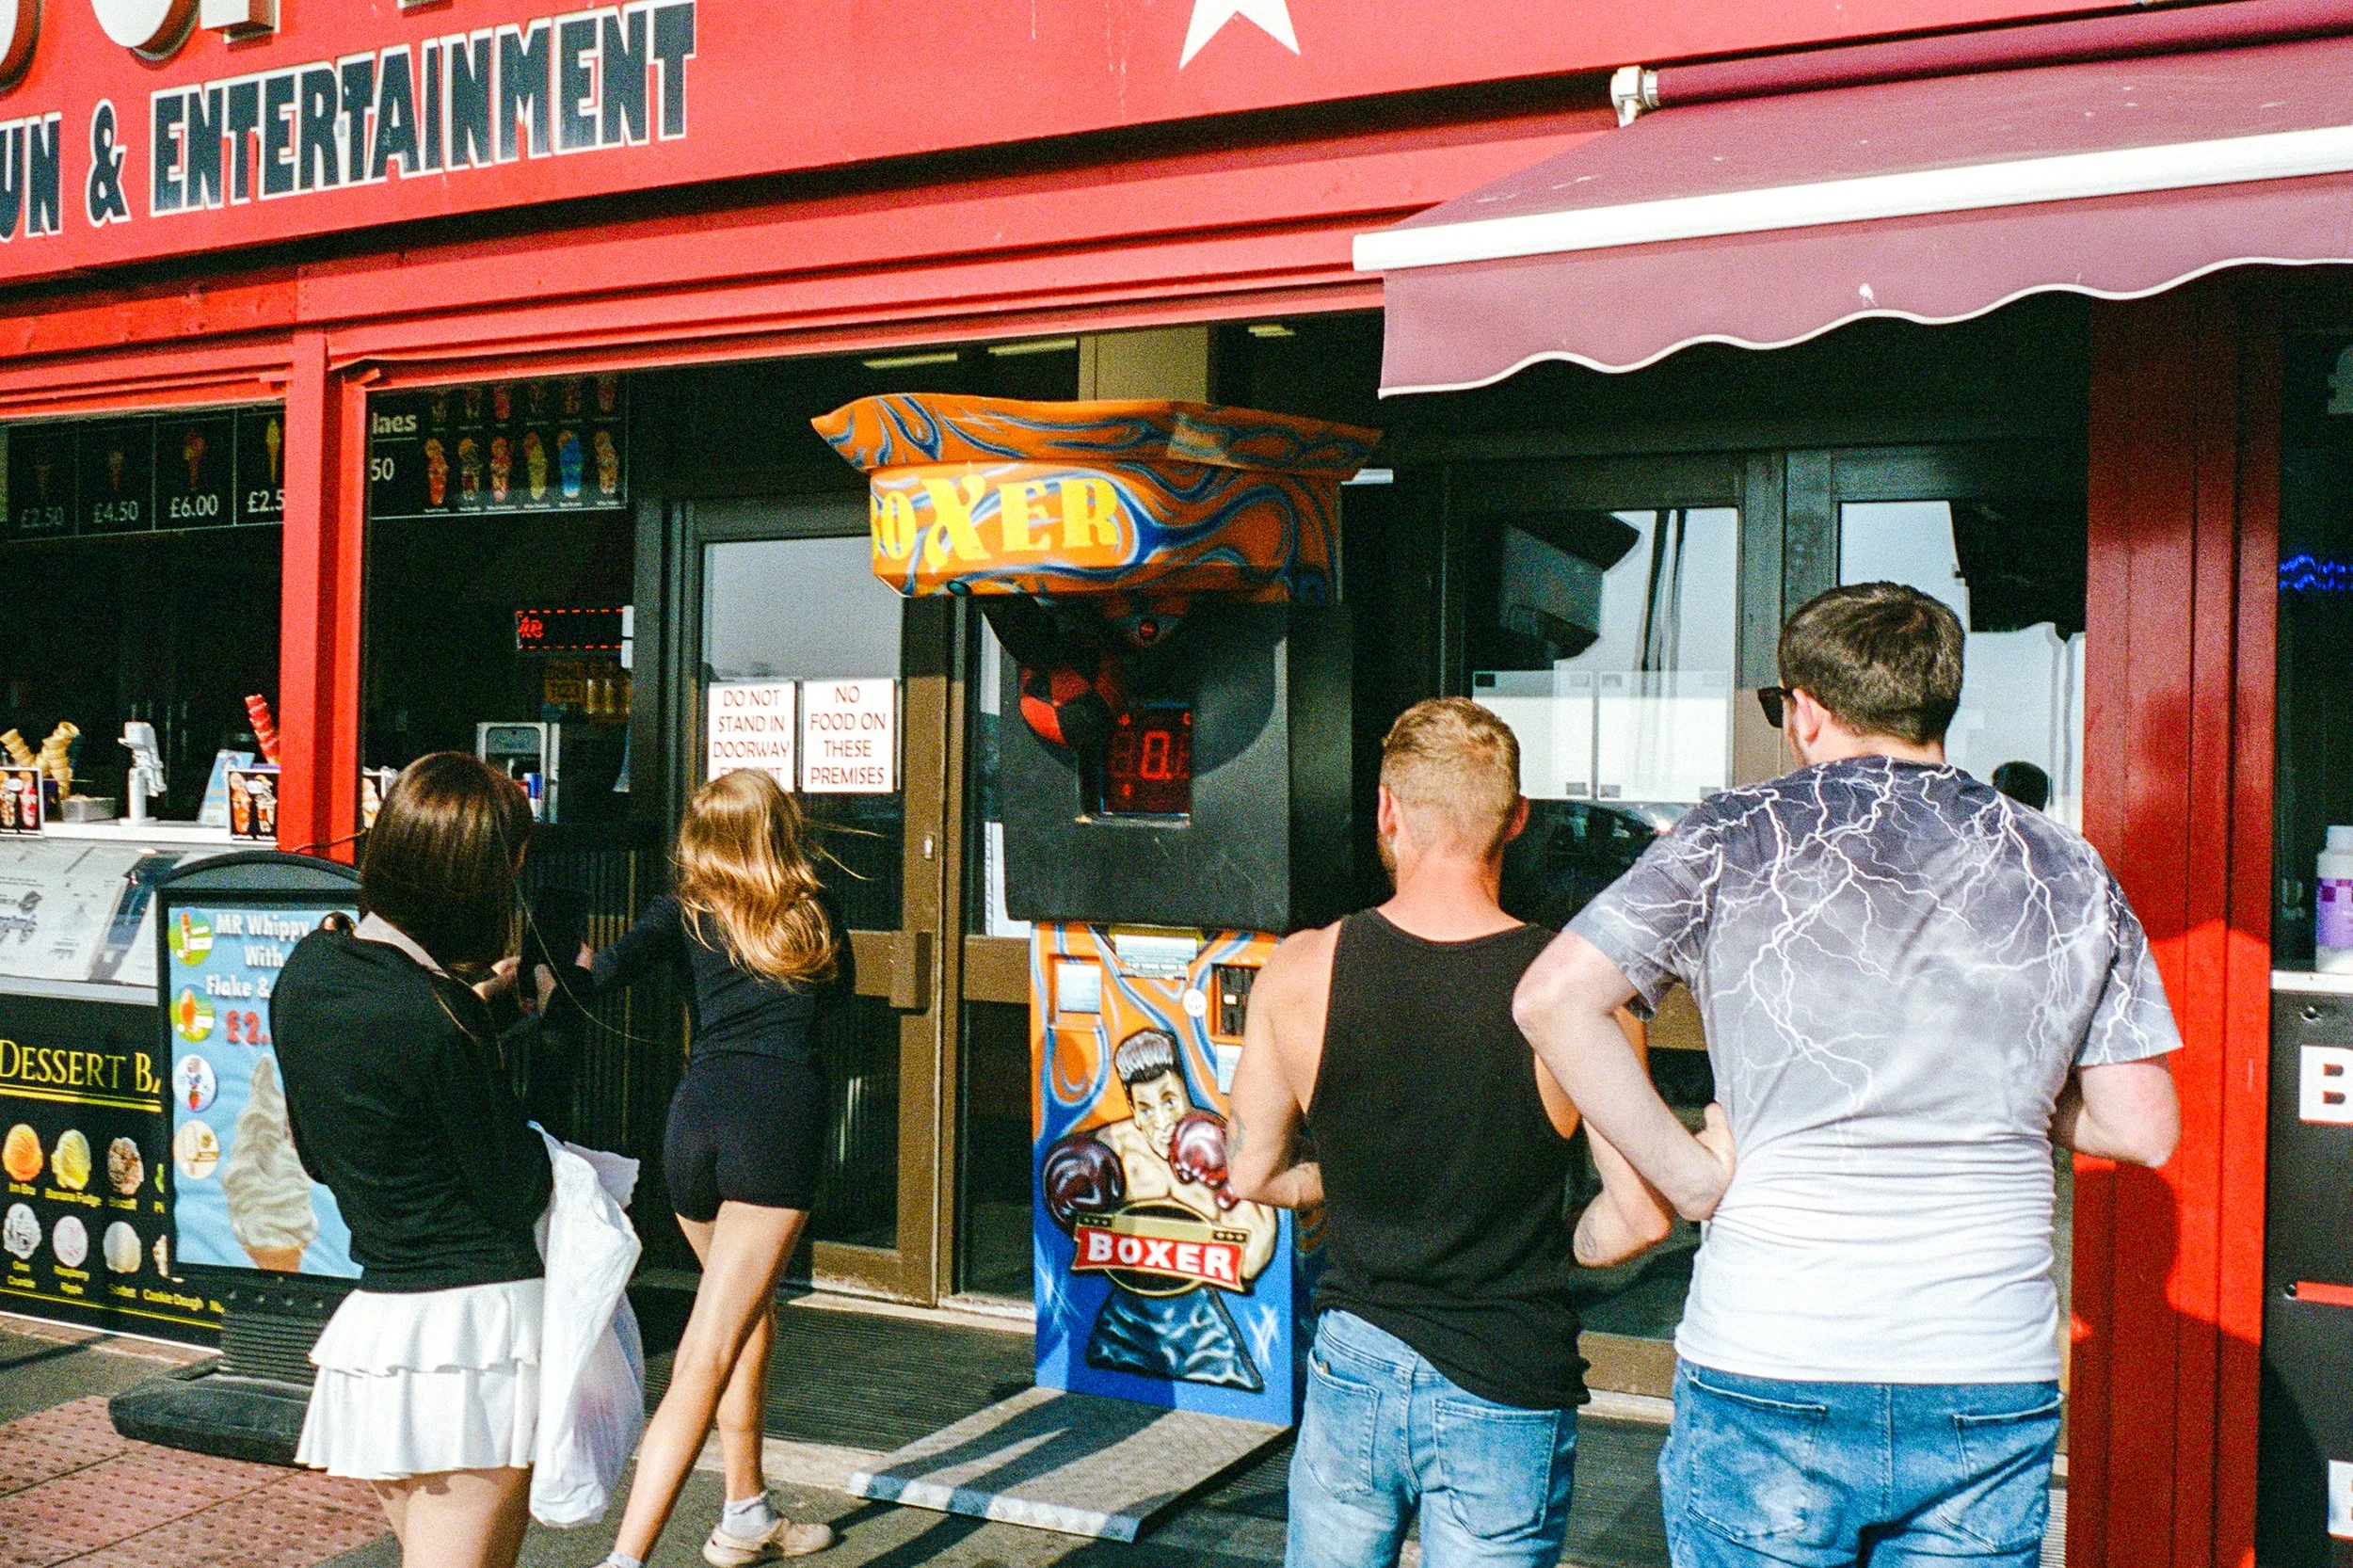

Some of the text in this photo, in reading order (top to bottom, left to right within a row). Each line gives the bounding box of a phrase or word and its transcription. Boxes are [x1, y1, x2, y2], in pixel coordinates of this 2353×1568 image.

[86, 98, 132, 228] &
[151, 0, 696, 217] ENTERTAINMENT
[94, 500, 138, 523] £4.50
[170, 495, 218, 518] £6.00
[723, 689, 780, 707] DO NOT
[835, 686, 860, 703] NO
[718, 715, 785, 732] STAND IN
[810, 712, 886, 730] FOOD ON
[713, 741, 790, 758] DOORWAY
[824, 740, 872, 758] THESE
[810, 767, 885, 785] PREMISES
[216, 914, 311, 941] MR Whippy
[244, 945, 284, 968] With
[205, 974, 253, 998] Flake
[0, 1039, 126, 1089] DESSERT
[1087, 1232, 1234, 1281] BOXER
